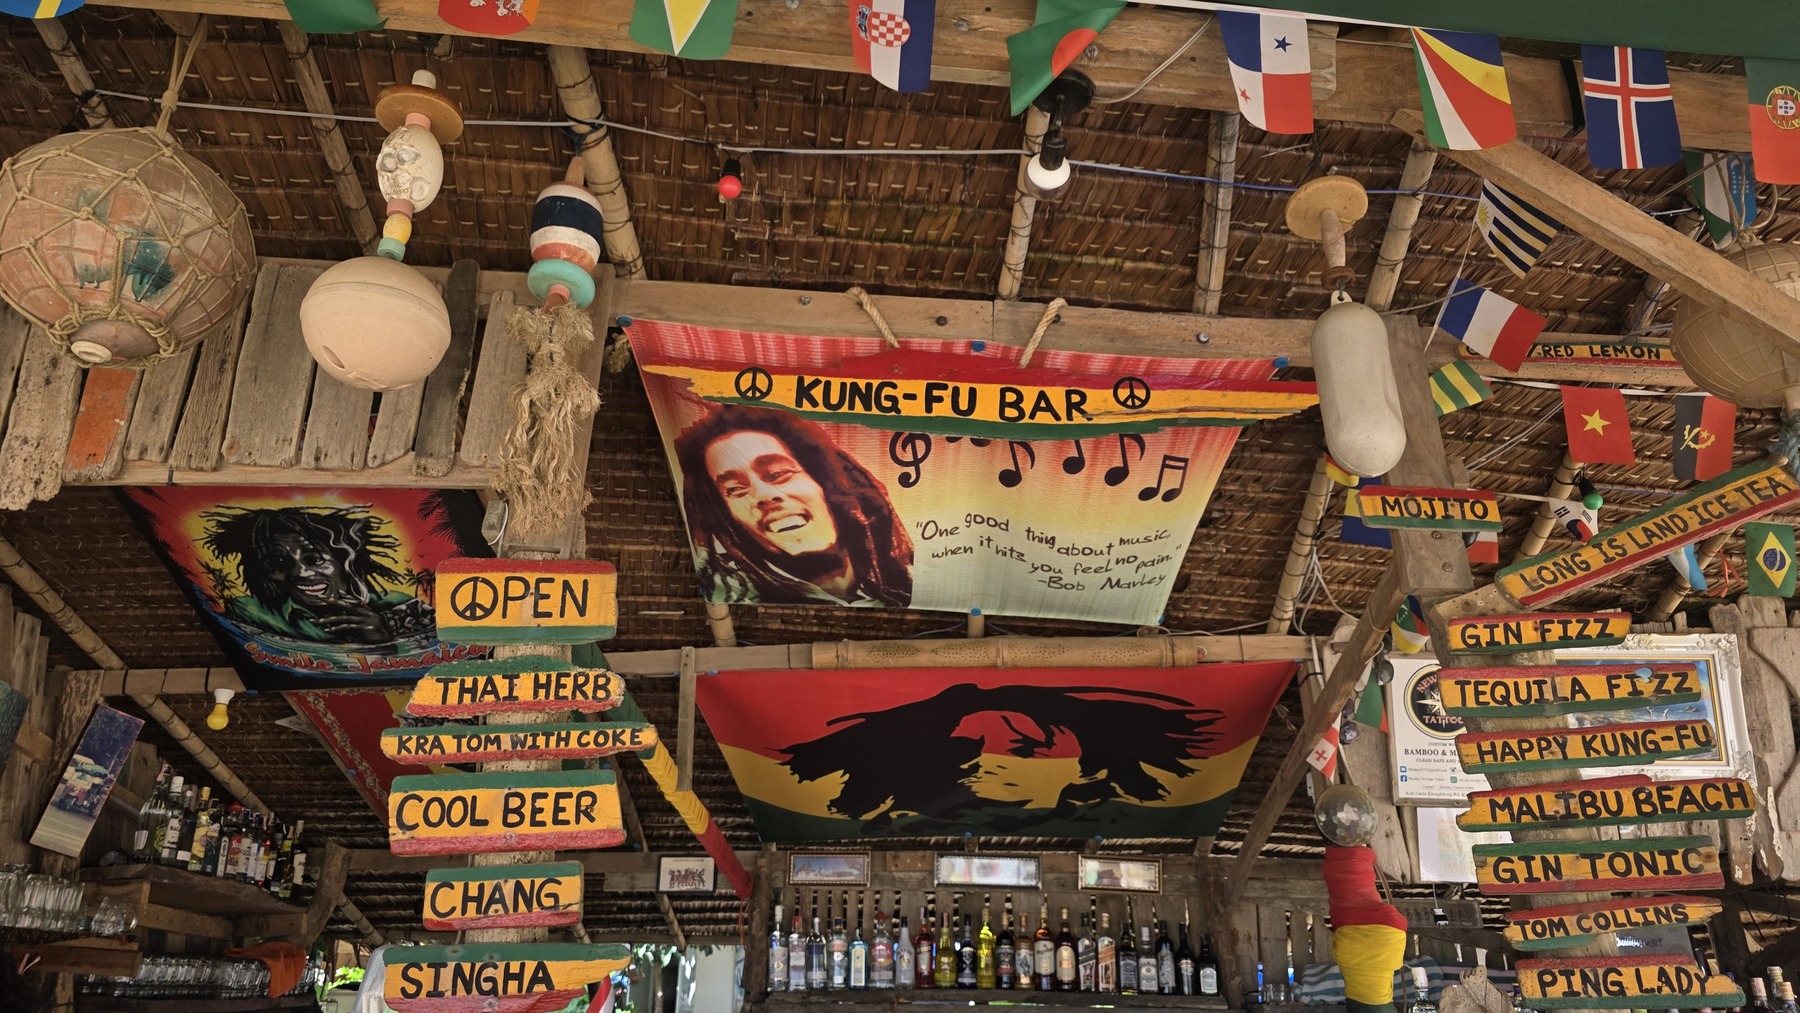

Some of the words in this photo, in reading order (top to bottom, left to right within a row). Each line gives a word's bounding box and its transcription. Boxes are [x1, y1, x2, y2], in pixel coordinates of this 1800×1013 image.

[1590, 345, 1661, 360] LEMON
[795, 376, 977, 416] KUNG-FU
[999, 386, 1093, 422] BAR
[1380, 495, 1489, 521] MOJITO
[965, 512, 1010, 532] good
[1025, 526, 1057, 550] thing
[1057, 542, 1116, 557] about
[1518, 552, 1592, 592] LONG
[1688, 494, 1734, 526] ICE
[1734, 475, 1794, 508] TEA
[931, 544, 973, 559] when
[979, 535, 994, 549] it
[995, 544, 1026, 563] hits
[1028, 562, 1063, 575] you
[1073, 559, 1113, 575] feel
[1115, 552, 1138, 566] no
[1100, 572, 1167, 591] Marley
[1460, 622, 1523, 649] GIN
[1539, 618, 1617, 641] FIZZ
[245, 641, 336, 671] Smile
[347, 642, 489, 674] Jamaica
[435, 673, 521, 705] THAI
[532, 671, 612, 702] HERB
[1454, 677, 1590, 707] TEQUILA
[1606, 672, 1693, 699] FIZZ
[510, 730, 571, 750] WITH
[576, 727, 645, 748] COKE
[1404, 748, 1439, 756] BAMBOO
[1477, 735, 1568, 764] HAPPY
[1582, 724, 1713, 757] KUNG-FU
[396, 793, 489, 832] COOL
[501, 790, 598, 829] BEER
[1489, 790, 1632, 823] MALIBU
[1632, 781, 1751, 817] BEACH
[1493, 855, 1563, 884] GIN
[1579, 848, 1705, 879] TONIC
[429, 878, 563, 919] CHANG
[1513, 916, 1574, 941] TOM
[1575, 903, 1690, 934] COLLINS
[399, 960, 555, 999] SINGHA
[1537, 967, 1625, 998] PING
[1635, 966, 1711, 996] LADY
